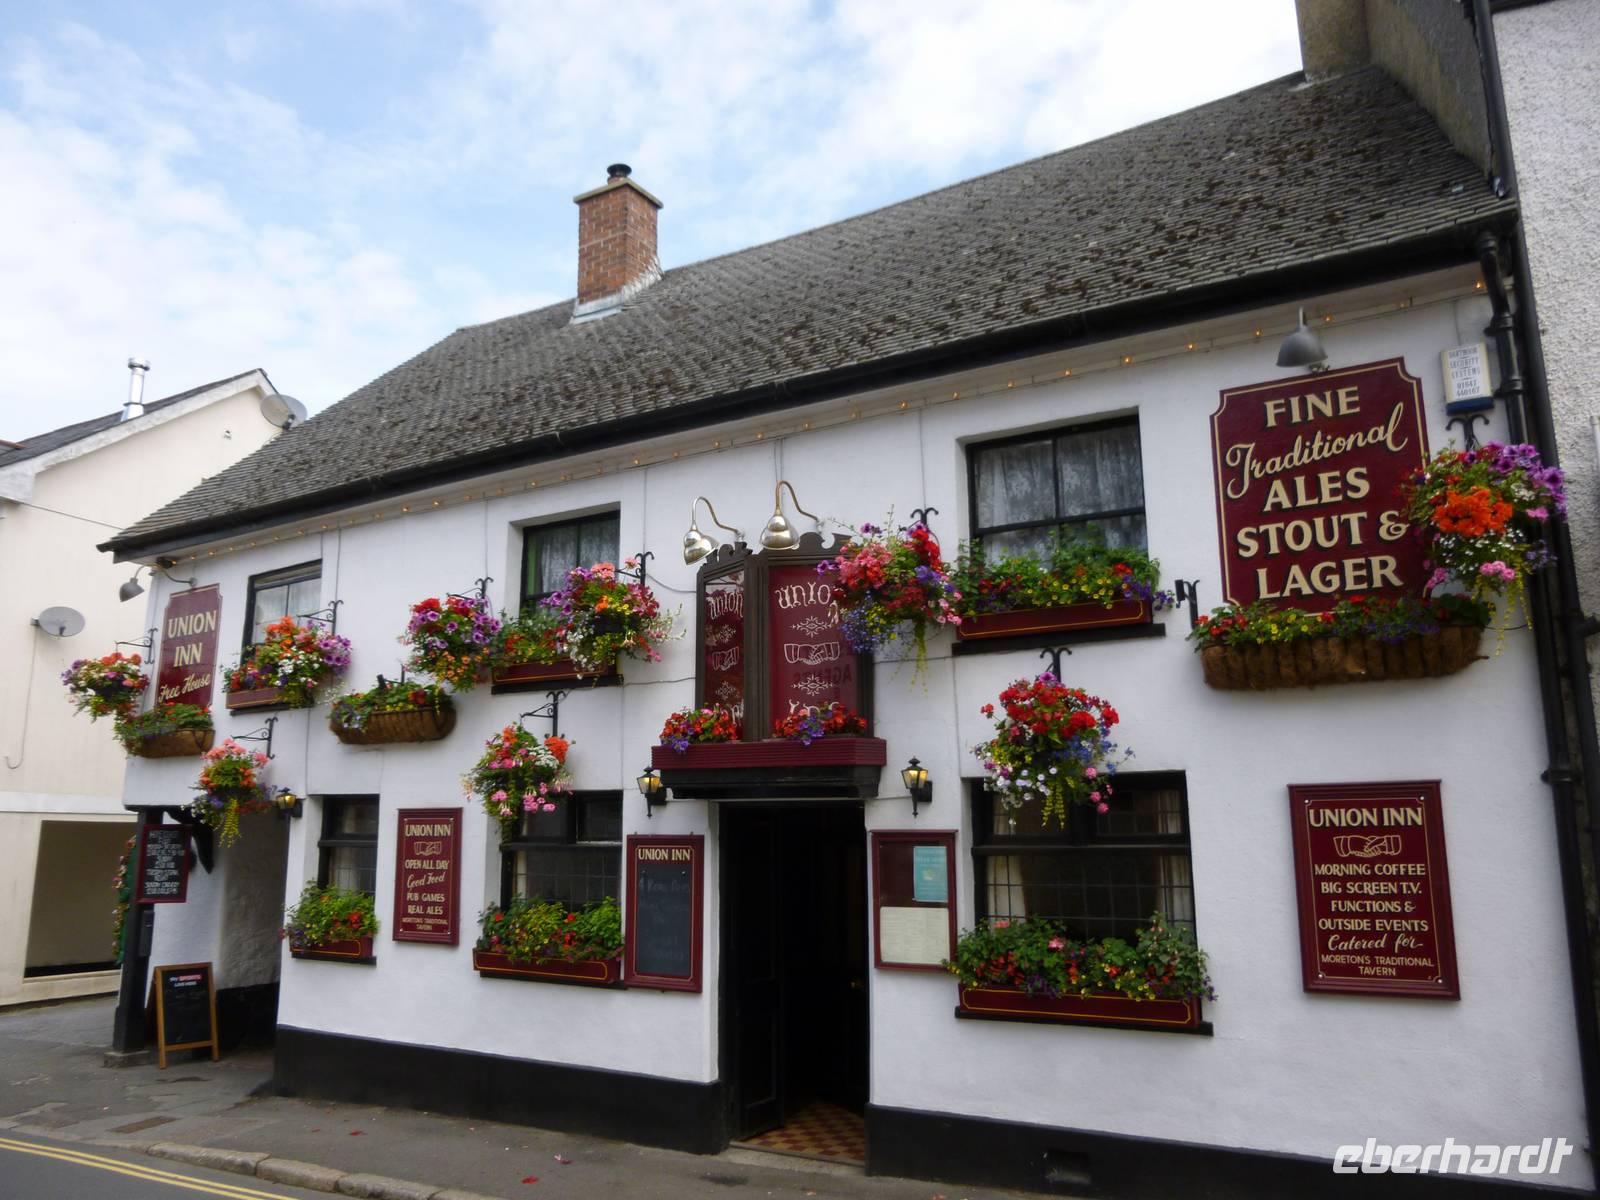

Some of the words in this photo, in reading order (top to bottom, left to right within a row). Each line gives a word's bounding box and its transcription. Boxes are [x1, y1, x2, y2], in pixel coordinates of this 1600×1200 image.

[1264, 386, 1361, 428] FINE
[1225, 402, 1408, 499] Traditional
[1262, 467, 1371, 513] ALES
[1236, 511, 1367, 558] STOUT
[1379, 510, 1409, 541] &
[1256, 554, 1404, 600] LAGER
[168, 610, 217, 638] UNION
[173, 642, 203, 668] INN
[158, 684, 181, 702] Free
[182, 673, 211, 694] House
[1309, 808, 1378, 828] UNION
[1383, 807, 1423, 826] INN
[405, 824, 433, 836] UNION
[434, 824, 451, 836] INN
[638, 848, 669, 861] UNION
[672, 848, 691, 861] INN
[404, 860, 422, 870] OPEN
[422, 860, 435, 870] ALL
[436, 860, 450, 870] DAY
[1314, 864, 1371, 876] MORNING
[1374, 864, 1426, 876] COFFEE
[407, 874, 425, 890] Good
[426, 872, 446, 885] Food
[1321, 882, 1342, 894] BIG
[1346, 882, 1398, 895] SCREEN
[1400, 882, 1422, 894] T.V.
[406, 892, 419, 902] PUB
[422, 893, 445, 902] GAMES
[408, 904, 424, 914] REAL
[426, 906, 443, 915] ALES
[1331, 900, 1401, 912] FUNCTIONS
[1404, 901, 1416, 912] &
[1318, 918, 1371, 931] OUTSIDE
[1376, 920, 1429, 932] EVENTS
[1328, 933, 1388, 951] Catered
[1394, 933, 1424, 953] for
[1375, 956, 1435, 967] TRADITIONAL
[1358, 966, 1396, 976] TAVERN
